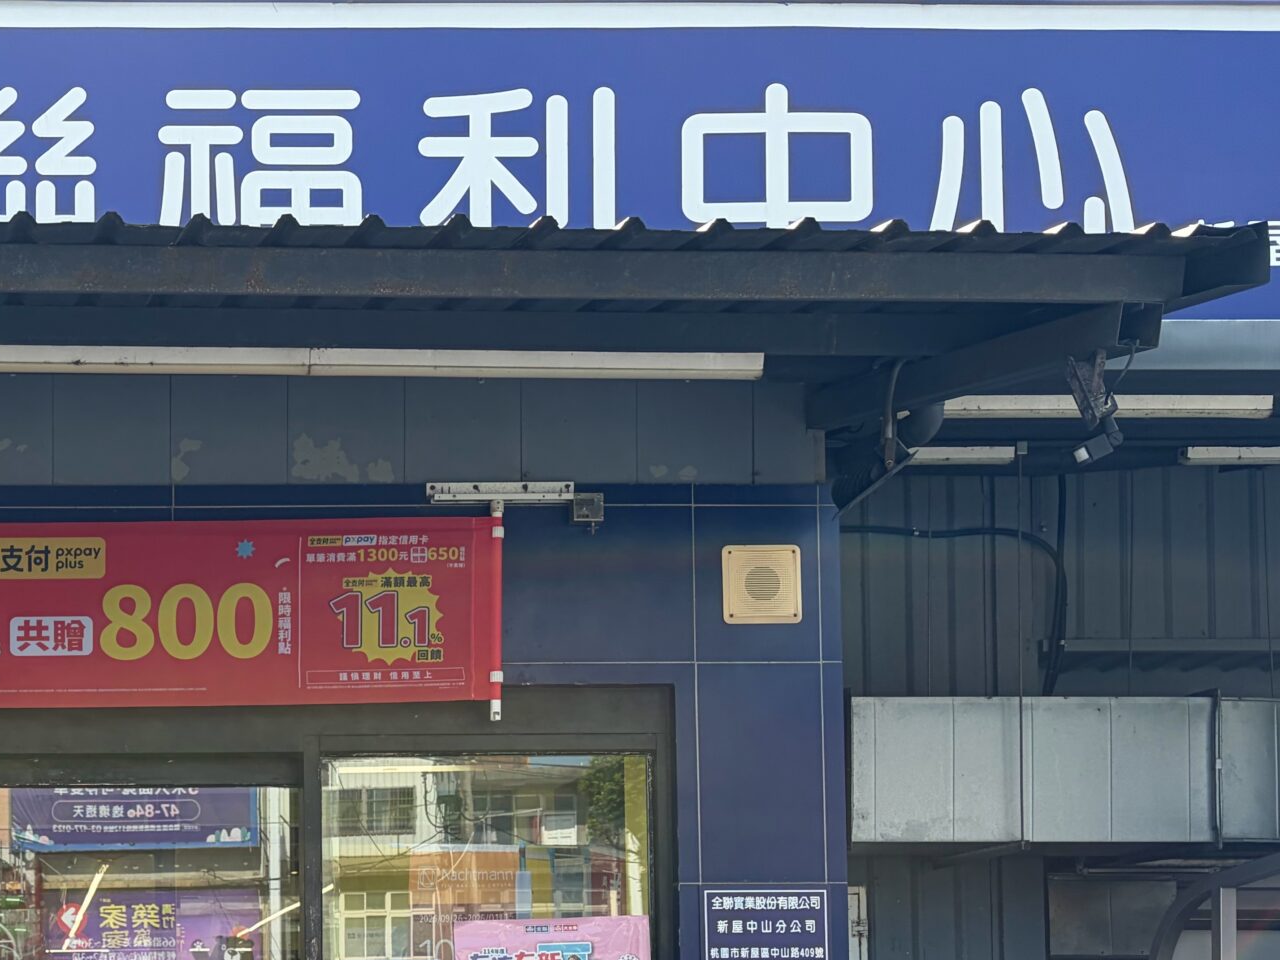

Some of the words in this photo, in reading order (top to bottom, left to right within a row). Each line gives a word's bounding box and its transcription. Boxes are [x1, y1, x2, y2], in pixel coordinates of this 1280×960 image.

[55, 546, 102, 560] pxpay
[55, 556, 85, 571] plus
[15, 618, 87, 652] 共贈
[100, 582, 274, 661] 800
[277, 591, 292, 655] 限時福利點
[441, 867, 515, 881] Nachtmann
[711, 895, 821, 911] 全聯實業股份有限公司
[716, 919, 817, 934] 新屋中山分公司
[710, 946, 825, 960] 桃園市新屋區中山路409號
